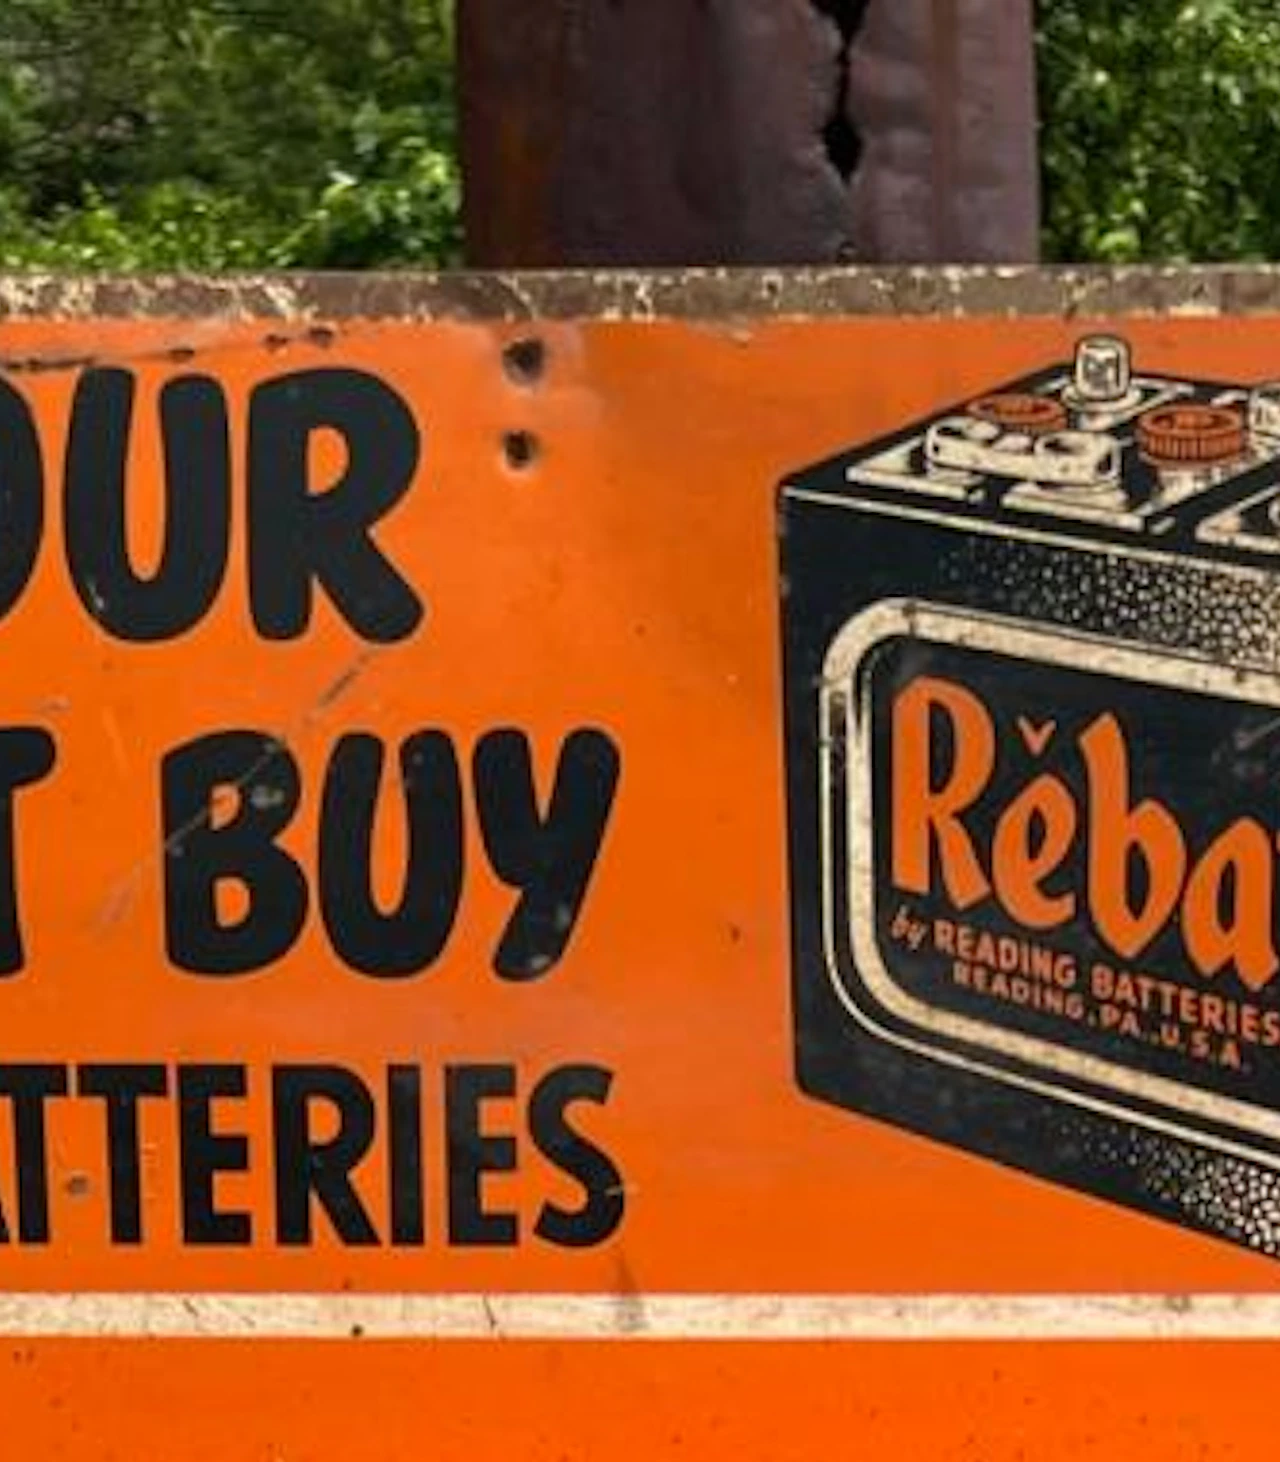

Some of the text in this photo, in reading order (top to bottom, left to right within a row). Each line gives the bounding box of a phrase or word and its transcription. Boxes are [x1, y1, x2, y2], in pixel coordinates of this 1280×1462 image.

[161, 726, 621, 983] BUY
[890, 905, 925, 950] by
[934, 919, 1077, 987] READING
